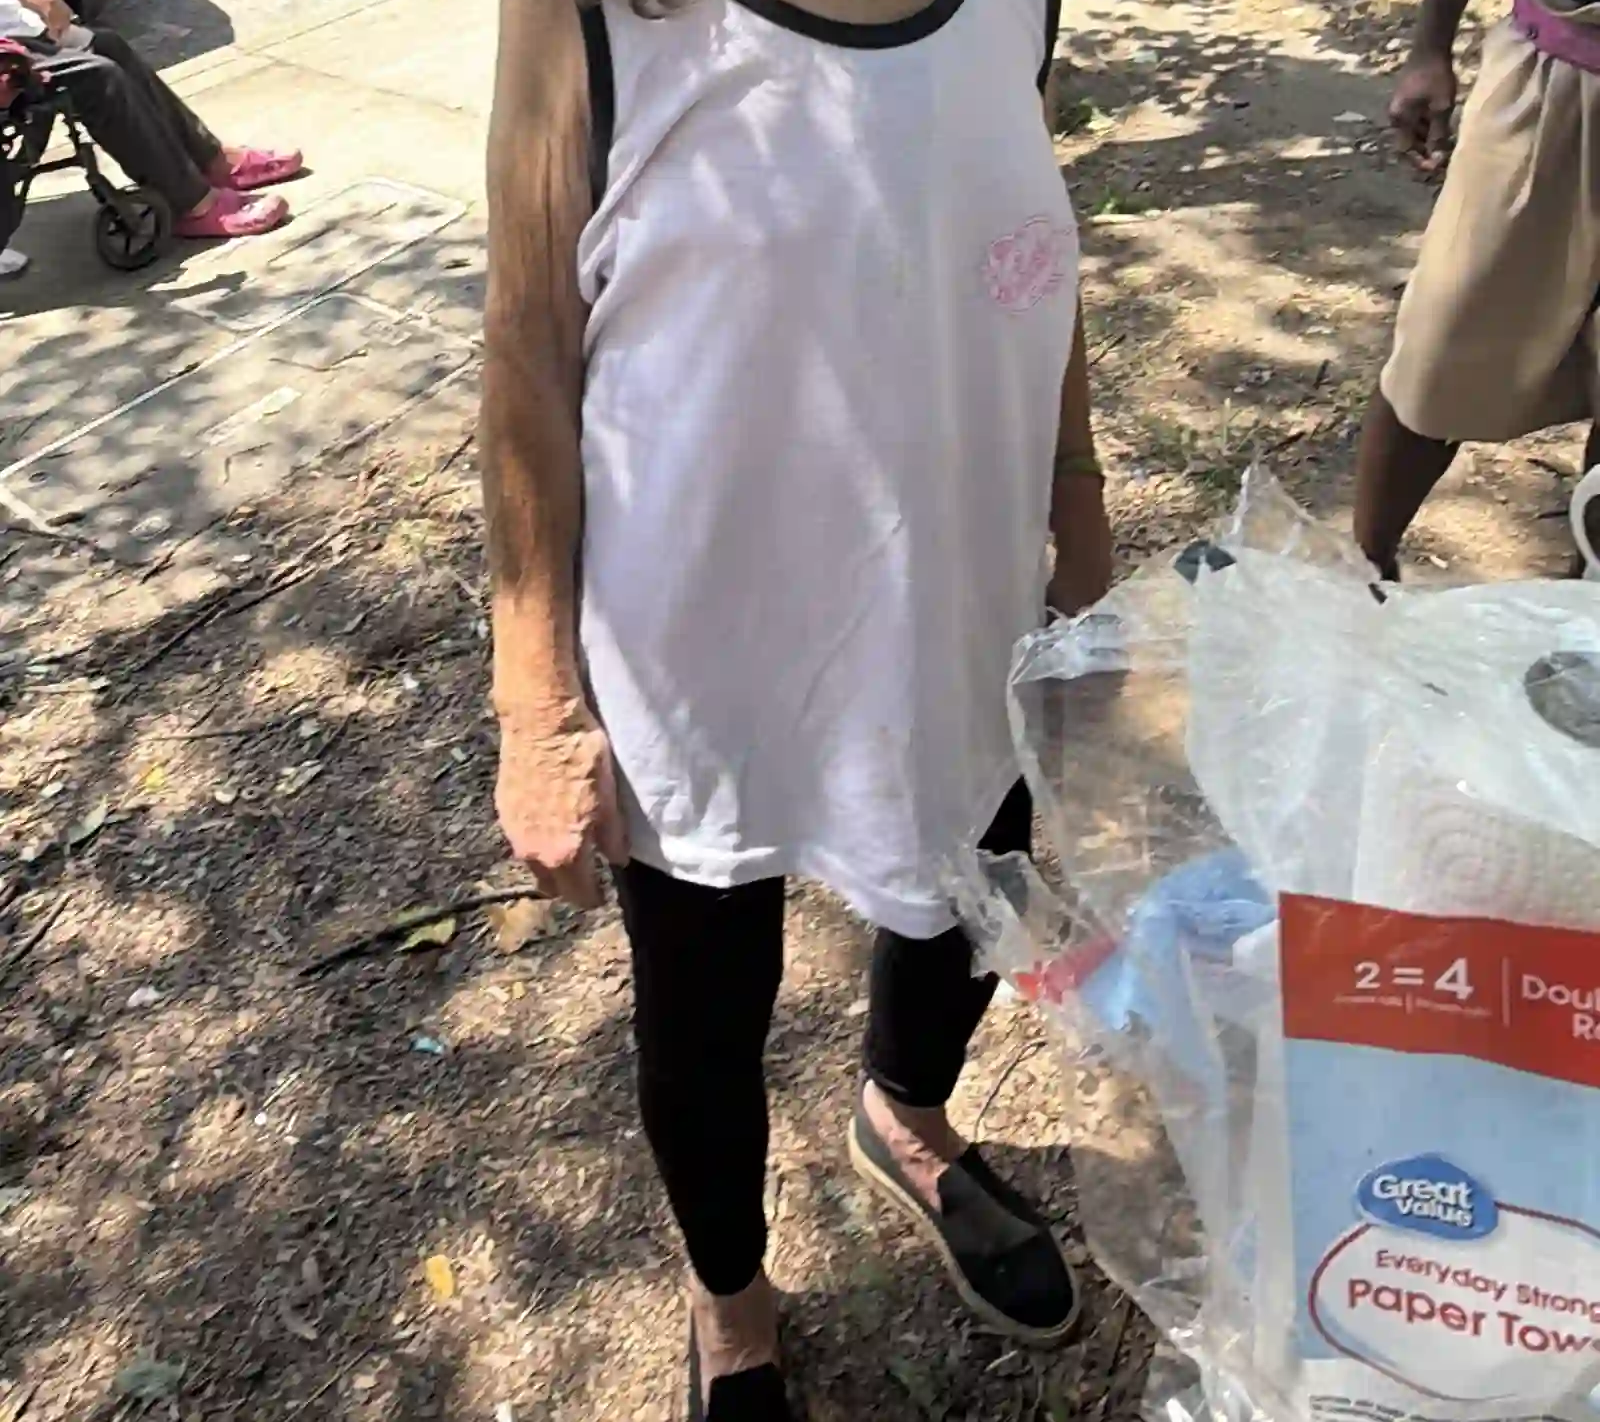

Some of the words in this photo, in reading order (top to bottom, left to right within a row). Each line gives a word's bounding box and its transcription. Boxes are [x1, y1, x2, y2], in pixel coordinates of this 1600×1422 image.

[1372, 1174, 1473, 1209] Great
[1376, 1249, 1507, 1301] Everyday
[1348, 1278, 1486, 1336] Paper
